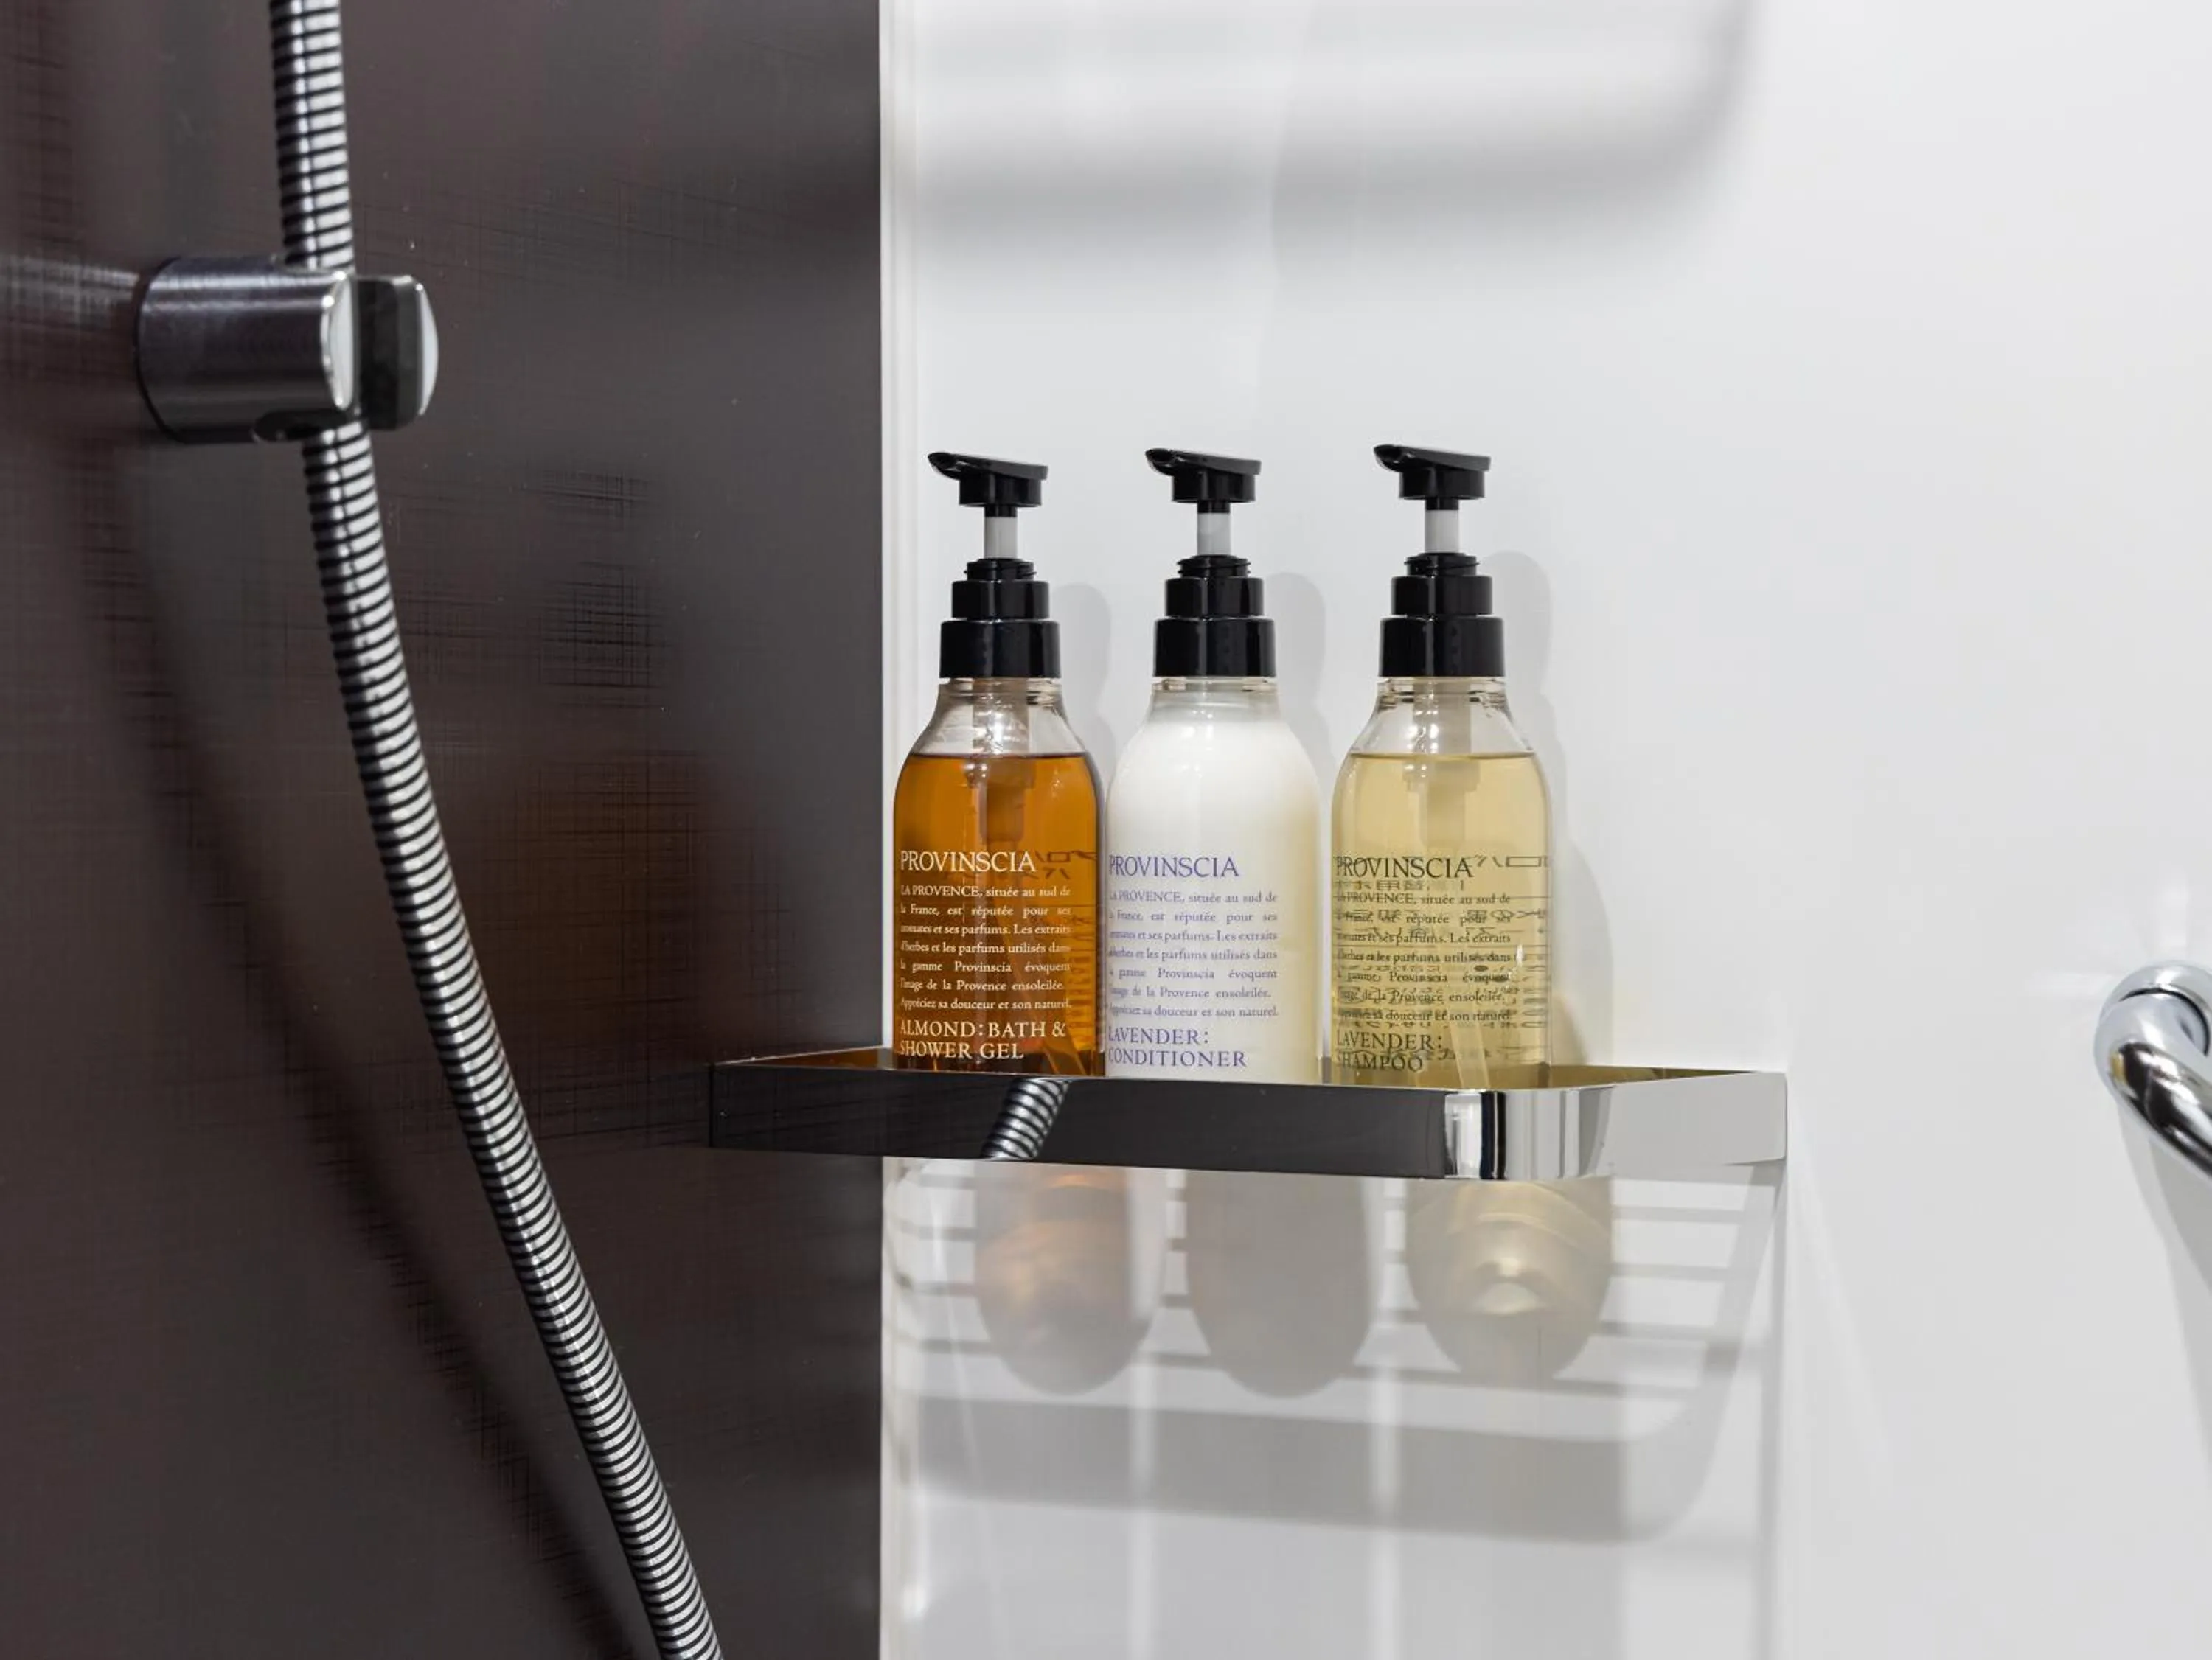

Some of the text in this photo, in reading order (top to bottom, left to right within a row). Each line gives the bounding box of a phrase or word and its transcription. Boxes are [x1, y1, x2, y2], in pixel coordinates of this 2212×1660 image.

[900, 850, 1036, 873] PROVINSCIA
[1108, 854, 1239, 878] PROVINSCIA
[1337, 856, 1475, 879] PROVINSCIA
[912, 885, 984, 898] PROVENCE,
[986, 886, 1018, 897] située
[1039, 886, 1057, 897] sud
[1118, 890, 1185, 903] PROVENCE,
[1189, 893, 1222, 903] située
[1243, 891, 1262, 903] sud
[1265, 891, 1277, 903] de
[1475, 893, 1495, 904] sud
[1499, 893, 1511, 903] de
[911, 903, 940, 916] France,
[971, 906, 1014, 918] réputée
[1023, 907, 1048, 919] pour
[1175, 912, 1216, 925] réputée
[1226, 914, 1253, 925] pour
[945, 926, 959, 934] ses
[961, 923, 1011, 938] parfums.
[1014, 924, 1032, 934] Les
[1217, 930, 1236, 941] Les
[1238, 932, 1278, 941] extraits
[1450, 932, 1470, 943] Les
[931, 944, 941, 952] et
[942, 941, 956, 953] les
[959, 941, 1005, 956] parfums
[1008, 941, 1046, 953] utilisés
[1147, 947, 1159, 959] les
[1162, 946, 1206, 961] parfums
[1253, 949, 1278, 960] dans
[955, 960, 1012, 972] Provinscia
[1157, 966, 1214, 979] Provinscia
[1228, 969, 1278, 982] évoquent
[926, 979, 938, 990] de
[942, 979, 952, 990] la
[956, 980, 1007, 991] Provence
[1160, 986, 1209, 997] Provence
[950, 998, 995, 1010] douceur
[998, 1002, 1008, 1010] et
[1011, 1002, 1032, 1010] son
[1154, 1005, 1198, 1016] douceur
[1201, 1008, 1212, 1016] et
[1450, 1012, 1470, 1021] son
[988, 1021, 1046, 1038] BATH
[1051, 1022, 1066, 1038] &
[900, 1039, 1024, 1059] SHOWER GEL
[1108, 1048, 1248, 1067] CONDITIONER
